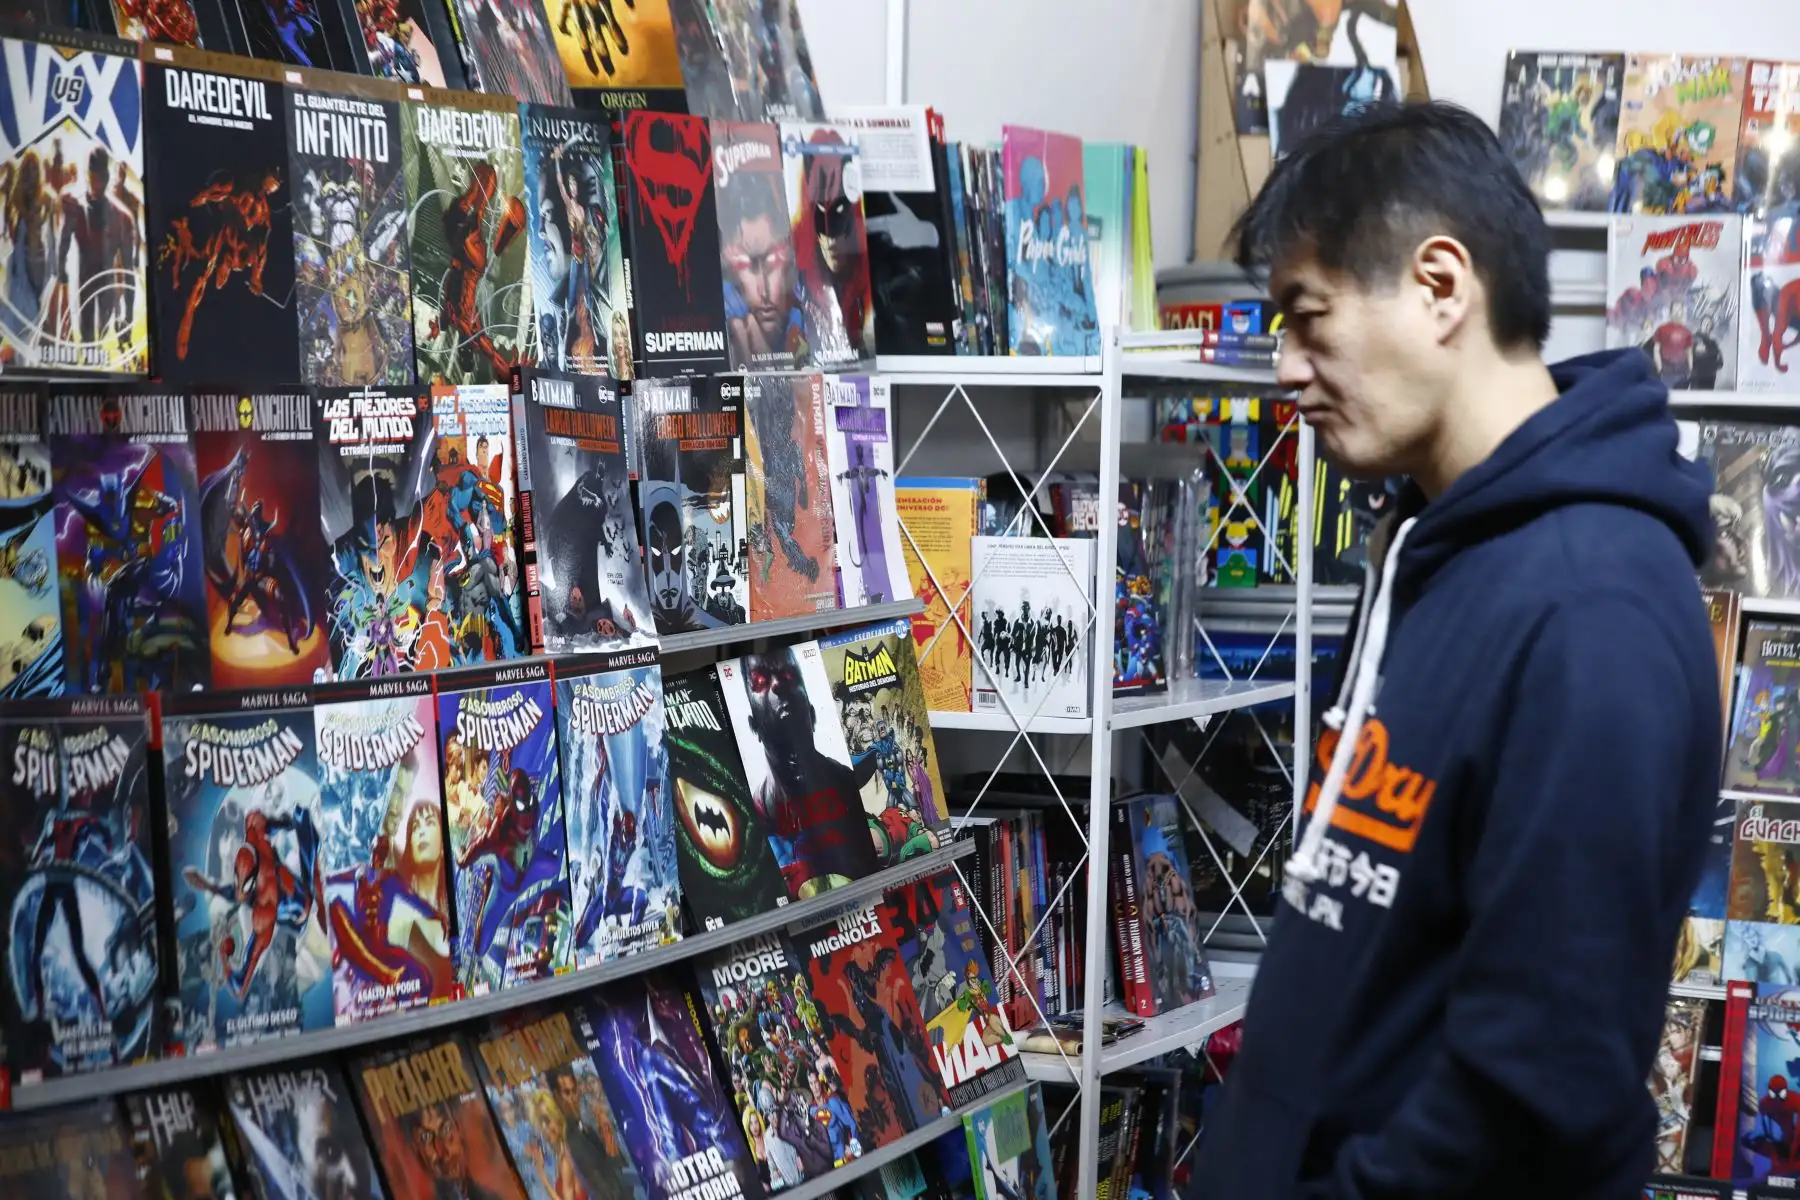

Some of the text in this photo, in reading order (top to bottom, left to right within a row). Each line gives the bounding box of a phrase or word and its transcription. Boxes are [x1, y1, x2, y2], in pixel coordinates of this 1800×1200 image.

[54, 77, 82, 102] VS
[165, 68, 272, 120] DAREDEVIL
[600, 92, 647, 108] ORIGEN
[294, 93, 387, 119] EL GUANTELETE DEL
[294, 109, 389, 163] INFINITO
[416, 107, 509, 149] DAREDEVIL
[526, 116, 600, 144] INJUSTICE
[715, 141, 772, 188] SUPERMAN
[644, 331, 725, 353] SUPERMAN
[531, 379, 574, 407] BATMAN
[643, 388, 689, 412] BATMAN
[720, 382, 731, 400] DC
[825, 382, 856, 406] BATMAN
[190, 394, 313, 432] BATMAN KNIGHTFALL
[323, 396, 417, 421] LOS MEJORES
[811, 383, 824, 436] BATMAN
[329, 416, 415, 444] DEL MUNDO
[572, 411, 617, 440] HALLOWEEN
[656, 411, 737, 440] LARGO HALLOWEEN
[371, 443, 406, 455] VISITANTE
[528, 565, 539, 597] BATMAN
[608, 651, 656, 668] MARVEL SAGA
[1761, 639, 1797, 658] HOTEL
[495, 666, 545, 682] MARVEL SAGA
[845, 646, 897, 686] BATMAN
[368, 680, 428, 697] MARVEL SAGA
[582, 676, 636, 701] ASOMBROSO
[848, 675, 897, 693] HISTORIAS DEL DEMONIO
[71, 699, 139, 714] MARVEL SAGA
[241, 692, 308, 708] MARVEL SAGA
[467, 690, 524, 718] ASOMBROSO
[571, 681, 656, 737] SPIDERMAN
[201, 718, 278, 747] ASOMBROSO
[456, 696, 544, 751] SPIDERMAN
[319, 712, 426, 772] SPIDERMAN
[184, 725, 304, 788] SPIDERMAN
[600, 921, 660, 945] LOS MUERTOS VIVEN
[836, 905, 879, 933] MIKE
[809, 920, 883, 959] MIGNOLA
[1128, 918, 1142, 949] KNIGHTFALL
[712, 949, 789, 988] MOORE
[357, 979, 421, 1004] ASALTO AL PODER
[1140, 998, 1147, 1010] 2
[226, 1020, 236, 1034] EL
[271, 1010, 298, 1026] DESEO
[362, 1041, 476, 1124] PREACHER
[672, 1146, 726, 1187] OTRA
